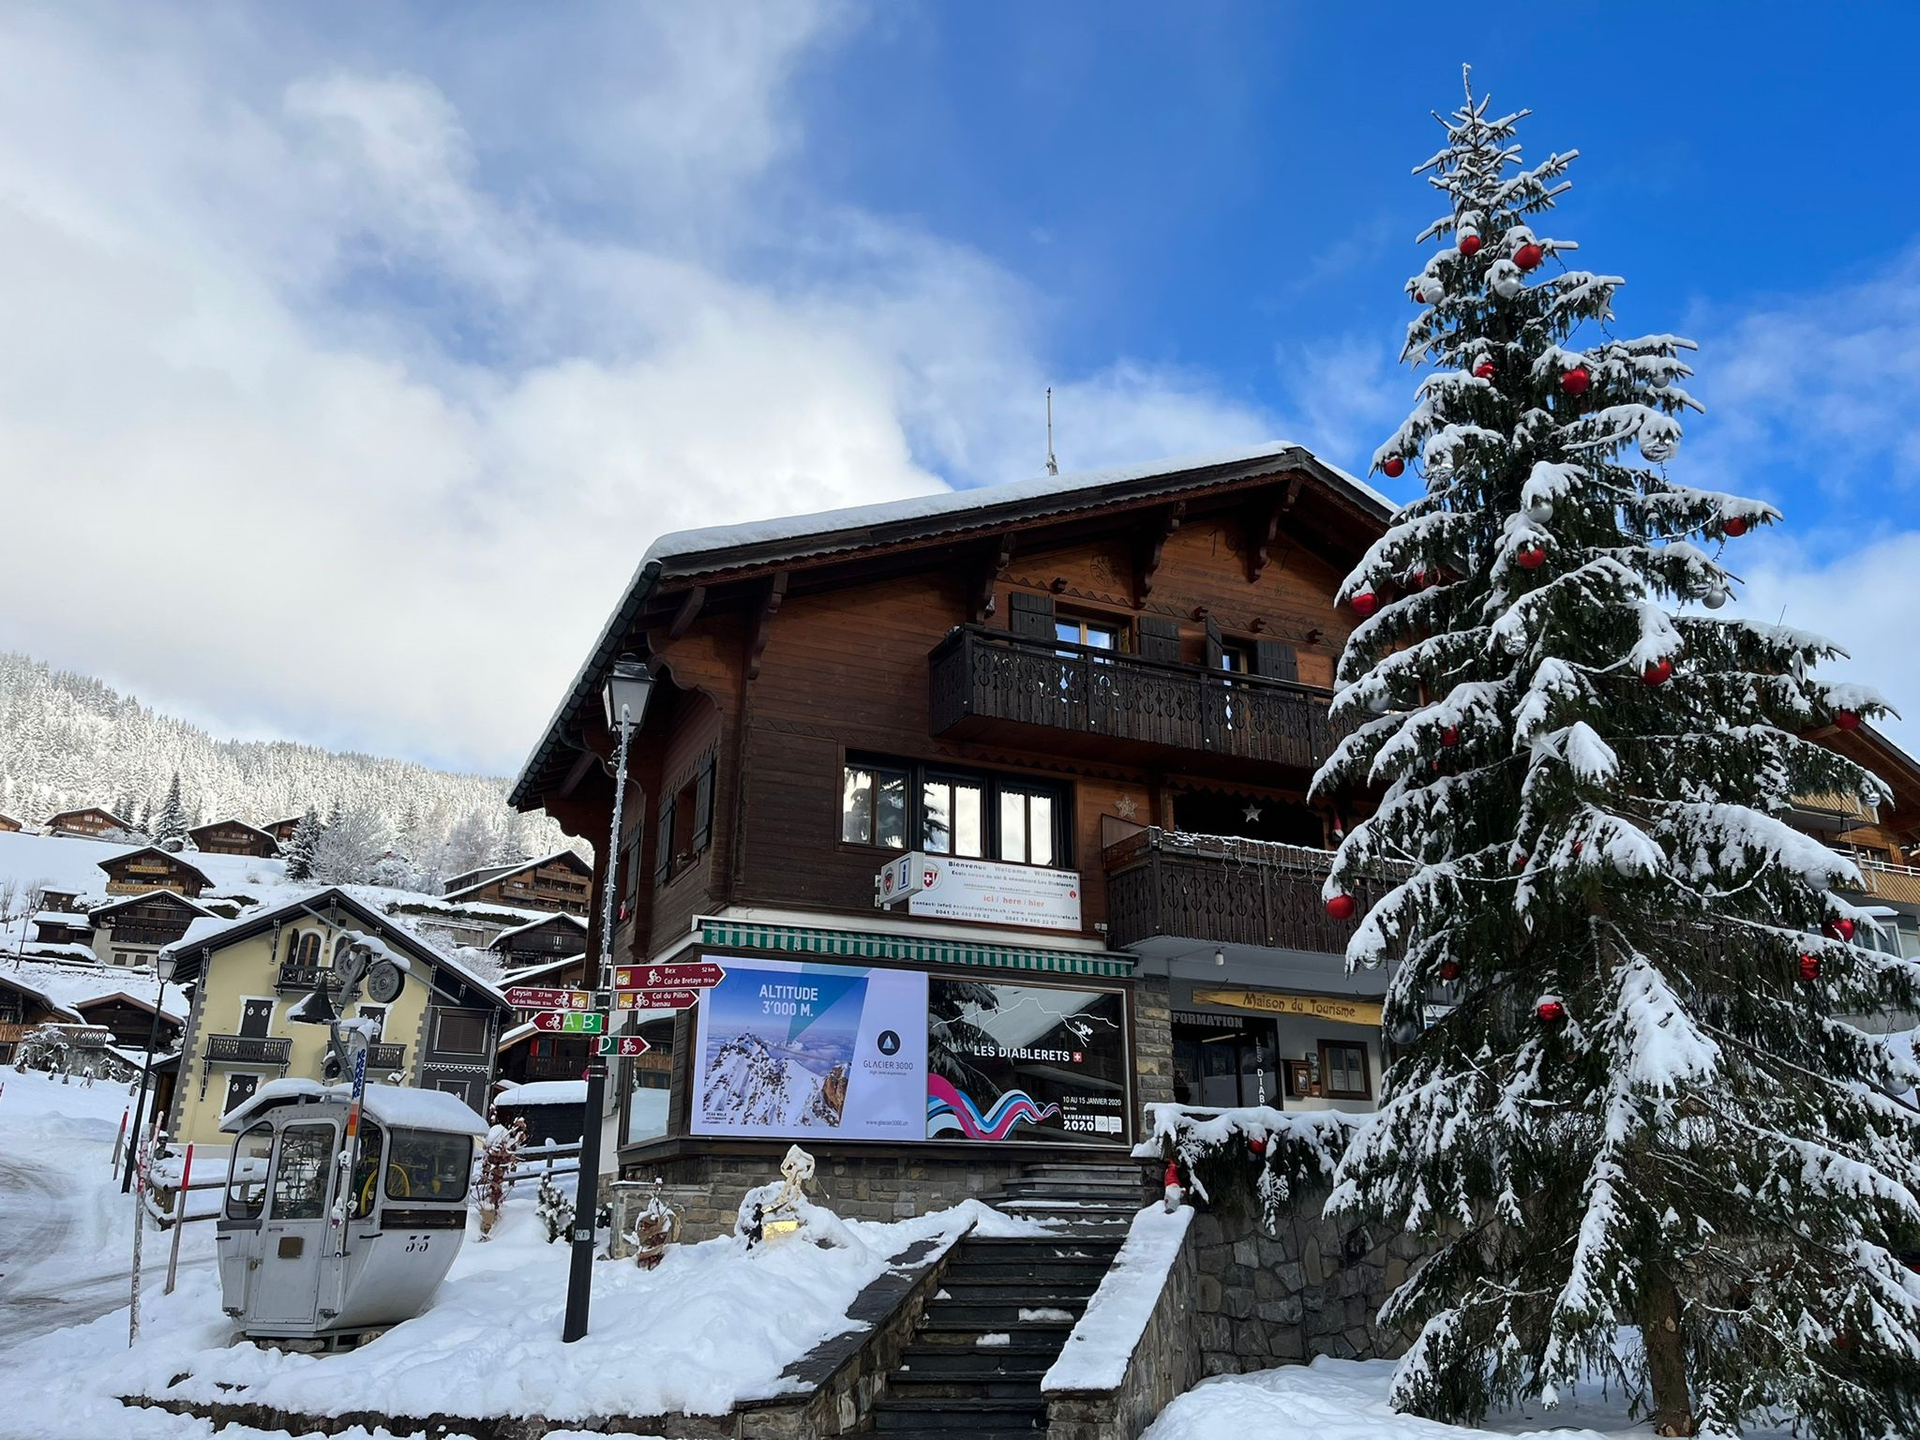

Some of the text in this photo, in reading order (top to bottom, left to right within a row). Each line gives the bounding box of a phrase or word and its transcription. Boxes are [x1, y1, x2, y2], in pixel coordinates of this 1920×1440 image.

[948, 861, 1077, 880] Bienvenue Welcome Willkommen
[1003, 897, 1021, 905] here
[1028, 899, 1044, 908] hier
[681, 977, 702, 985] Bretaye
[512, 989, 532, 998] Leysin
[652, 992, 661, 1000] Col
[663, 991, 671, 999] du
[759, 984, 819, 1001] ALTITUDE
[800, 1003, 814, 1017] M.
[1243, 992, 1356, 1018] Maison du Tourisme
[564, 1012, 594, 1029] A B
[1171, 1012, 1243, 1028] FORMATION
[600, 1036, 612, 1051] D
[974, 1045, 1070, 1062] LES DIABLERETS
[863, 1060, 914, 1071] GLACIER 3000
[1063, 1096, 1122, 1106] 10 AU 15 JANVIER 2020
